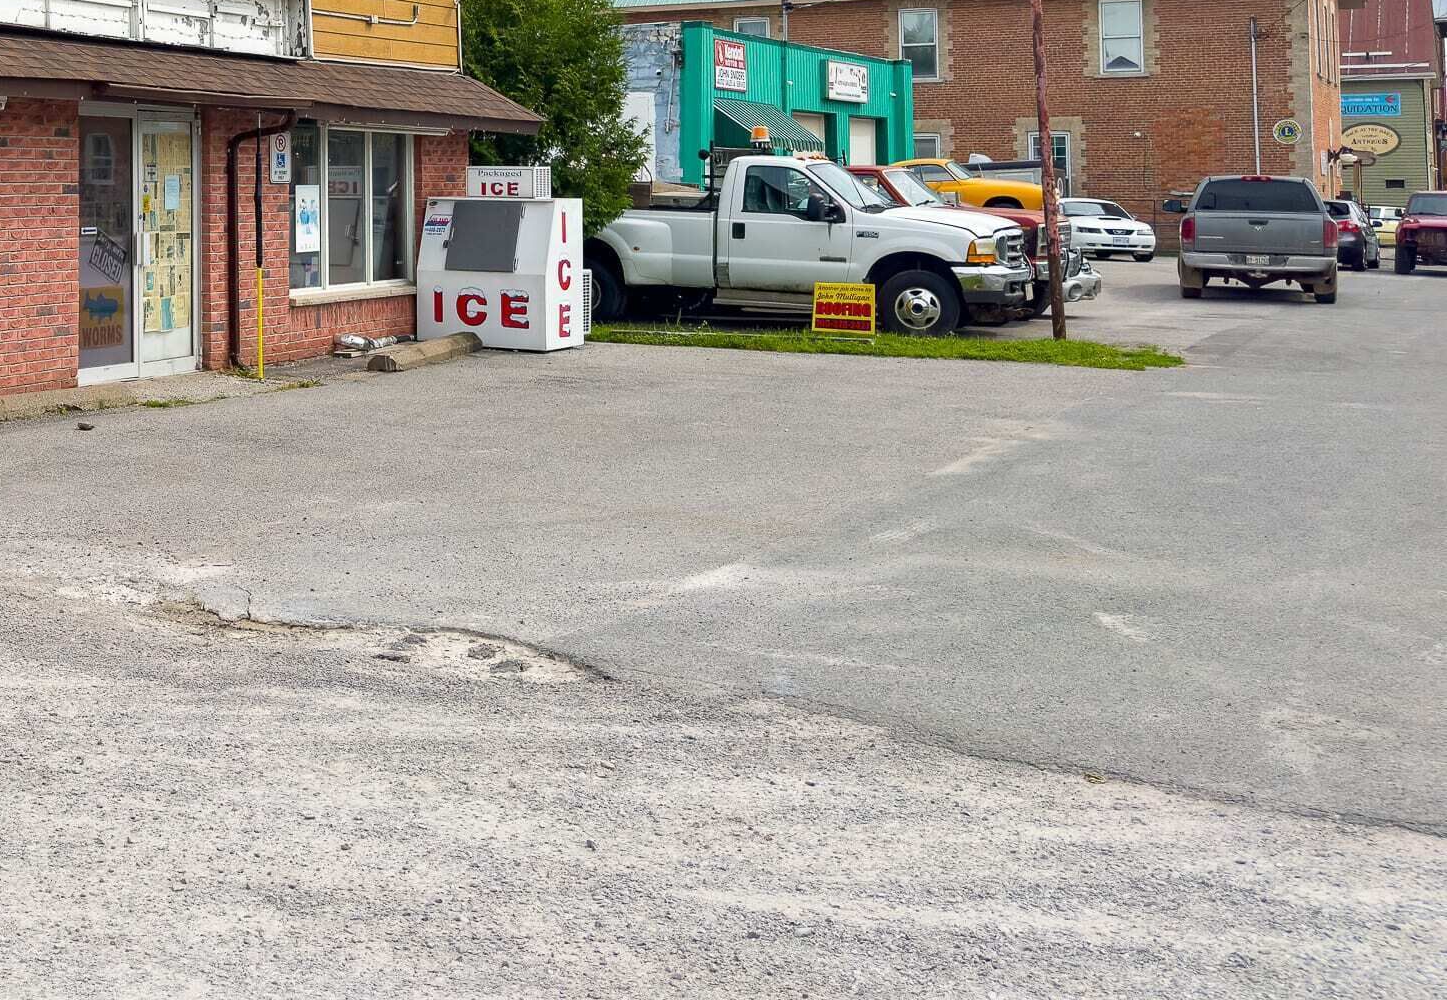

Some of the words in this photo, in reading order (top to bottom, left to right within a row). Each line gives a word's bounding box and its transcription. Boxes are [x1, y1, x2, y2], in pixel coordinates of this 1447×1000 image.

[718, 68, 729, 79] JOHN
[478, 169, 522, 177] Packaged
[481, 182, 519, 196] ICE
[92, 245, 123, 282] CLOSED
[817, 292, 834, 301] John
[433, 286, 530, 330] ICE
[82, 325, 123, 347] WORMS
